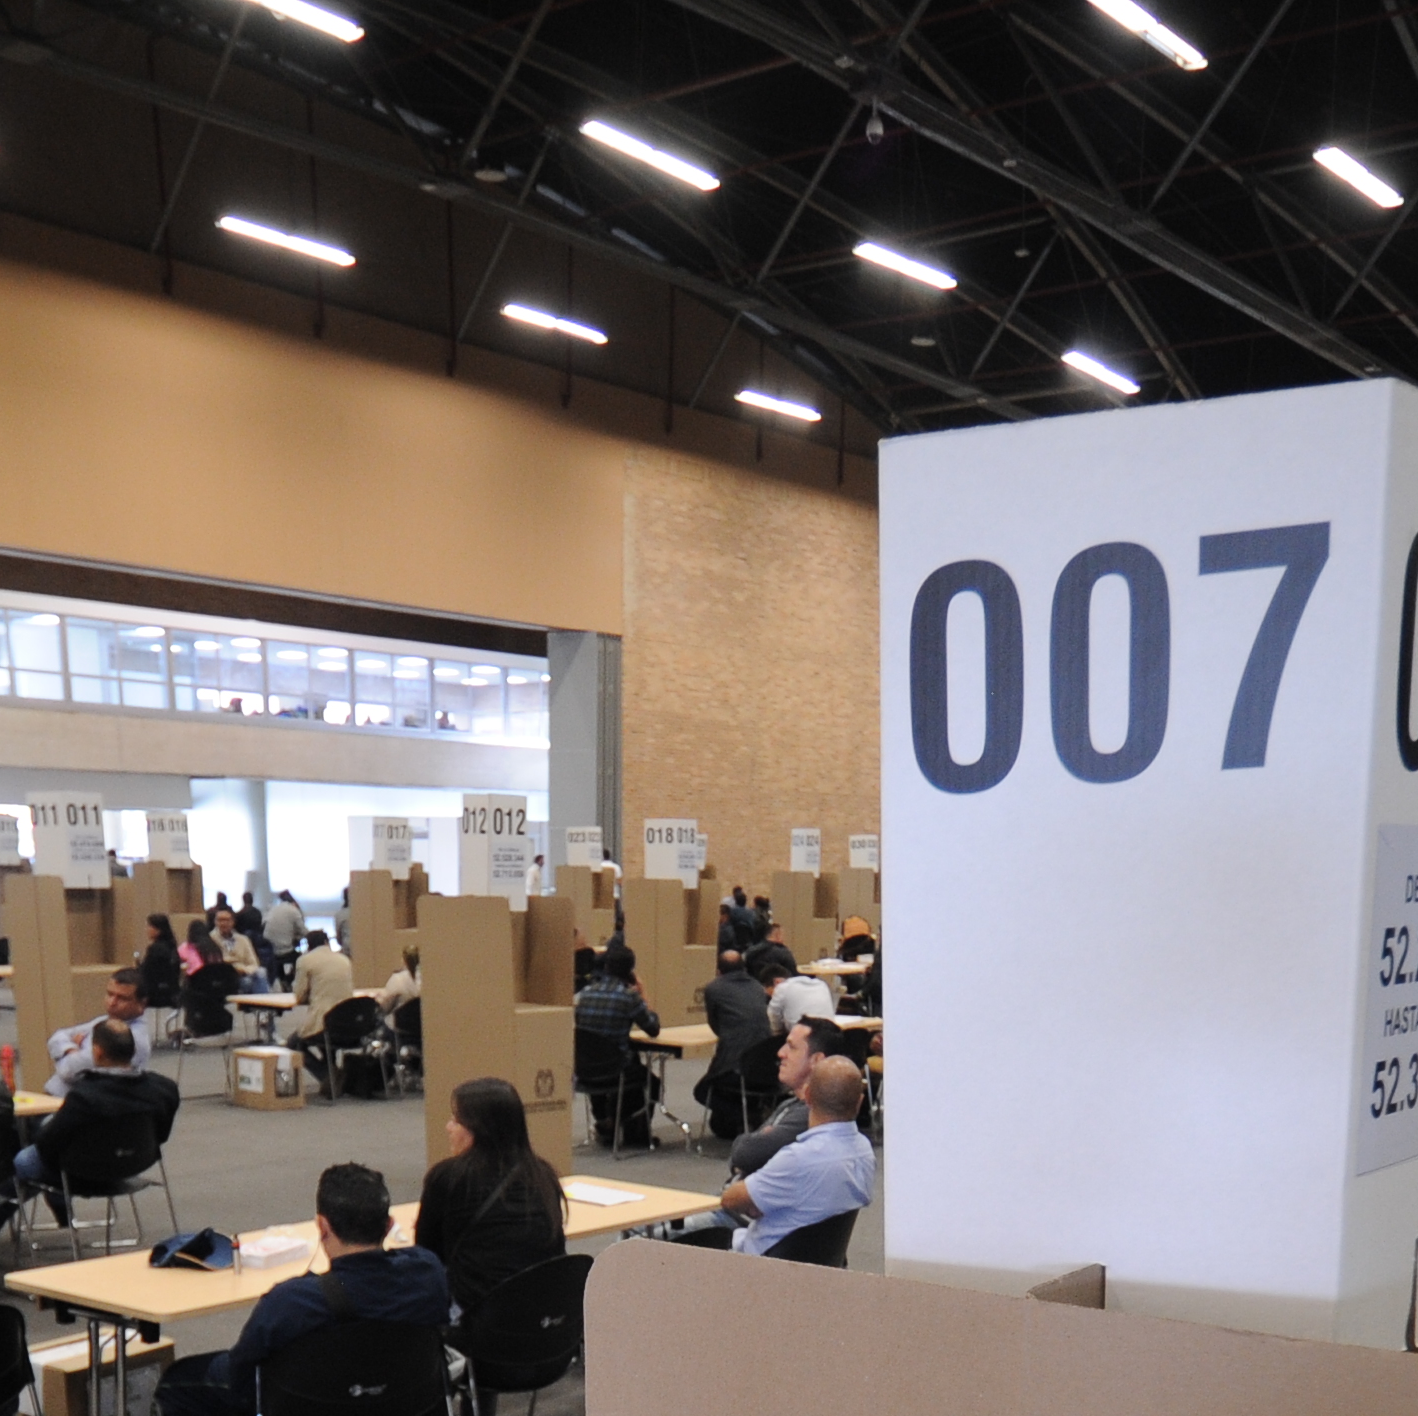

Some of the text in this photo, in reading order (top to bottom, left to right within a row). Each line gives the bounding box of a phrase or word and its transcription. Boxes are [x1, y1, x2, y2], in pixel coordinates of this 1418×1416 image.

[909, 520, 1331, 794] 007
[66, 803, 101, 826] 011
[462, 807, 487, 835] 012
[493, 807, 526, 836] 012
[646, 827, 674, 844] 018
